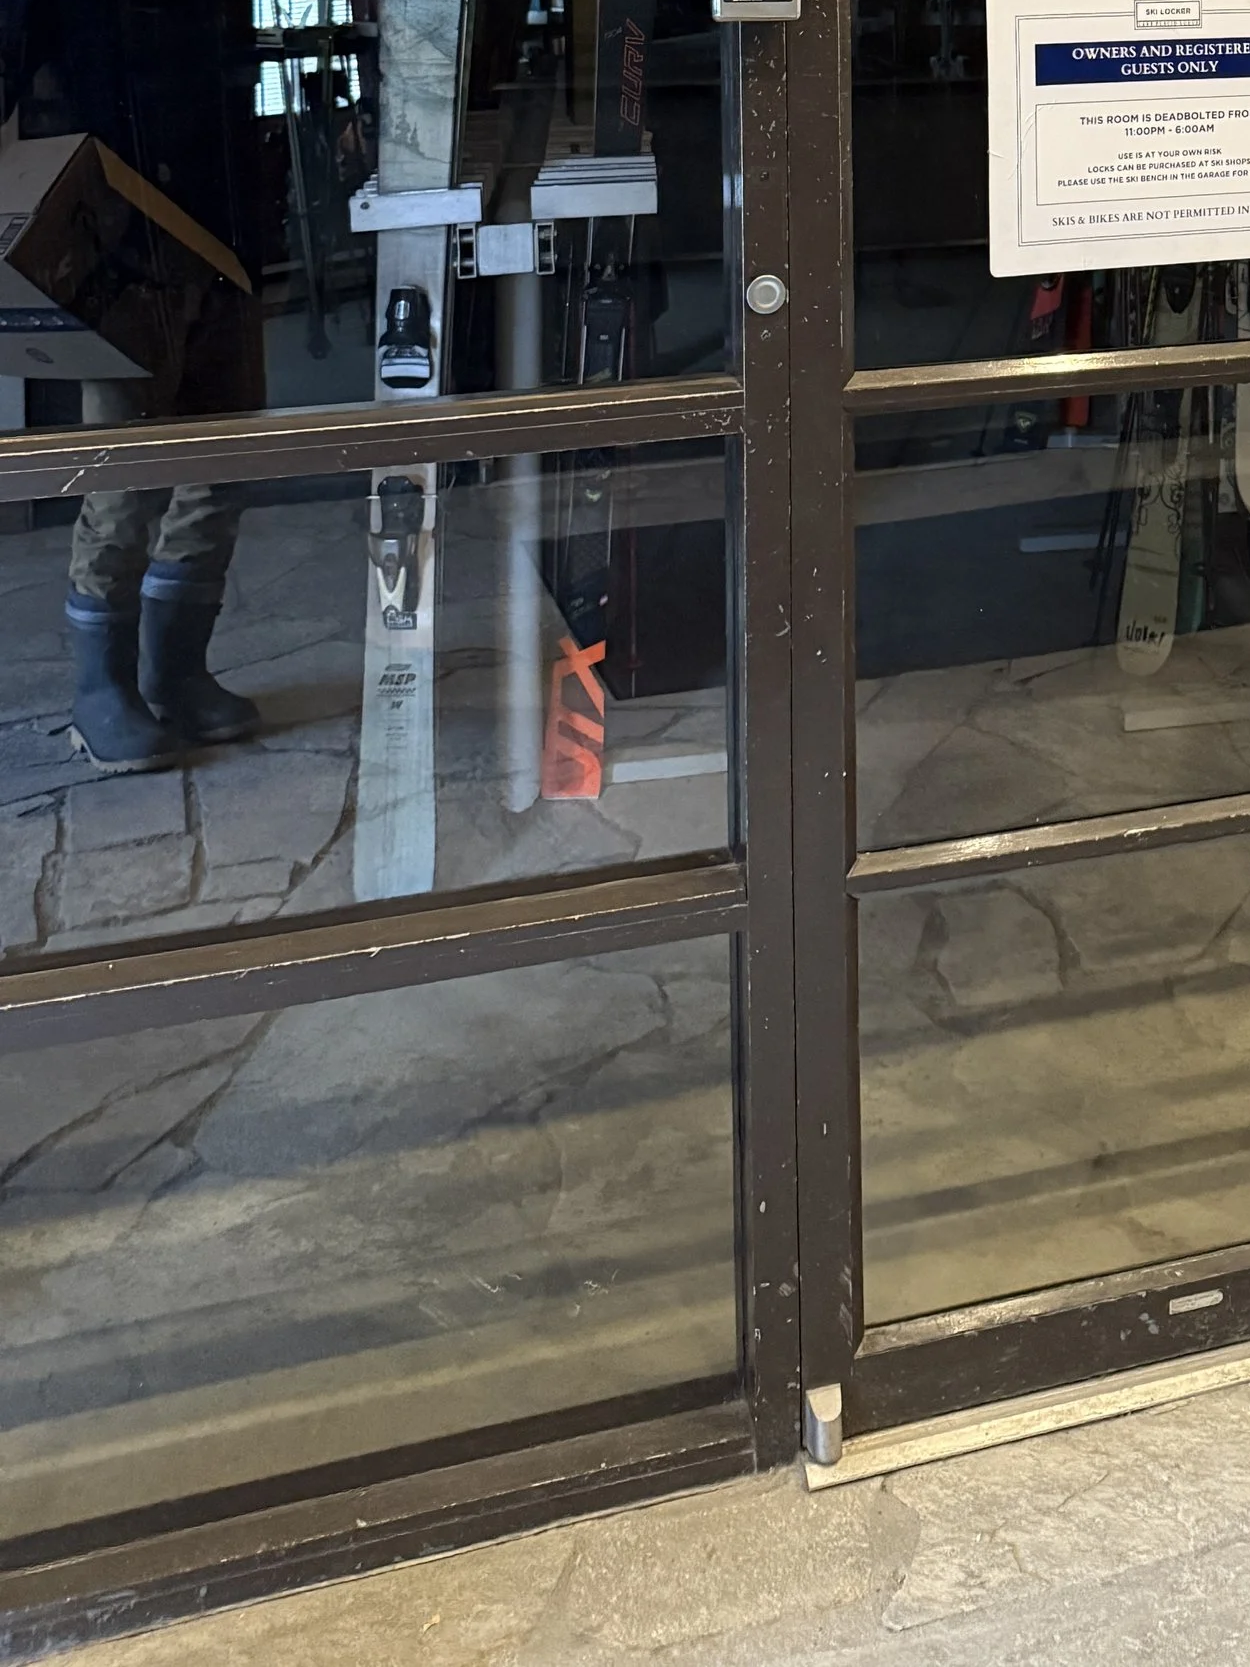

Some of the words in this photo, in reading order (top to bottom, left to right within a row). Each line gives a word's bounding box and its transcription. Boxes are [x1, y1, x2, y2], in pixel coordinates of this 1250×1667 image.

[1072, 46, 1136, 59] OWNERS
[1140, 45, 1172, 57] AND
[1121, 62, 1174, 75] GUESTS
[1178, 61, 1218, 73] ONLY
[1080, 116, 1103, 125] THIS
[1107, 115, 1138, 123] ROOM
[1143, 114, 1151, 122] IS
[1155, 111, 1225, 121] DEADBOLTED
[1125, 127, 1165, 136] 11:00PM
[1176, 124, 1214, 133] 6:00AM
[1149, 161, 1196, 169] PURCHASED
[1053, 217, 1075, 226] SKIS
[1090, 214, 1119, 223] BIKES
[1123, 212, 1143, 221] ARE
[1147, 211, 1170, 220] NOT
[1174, 207, 1234, 218] PERMITTED
[1239, 206, 1249, 214] IN
